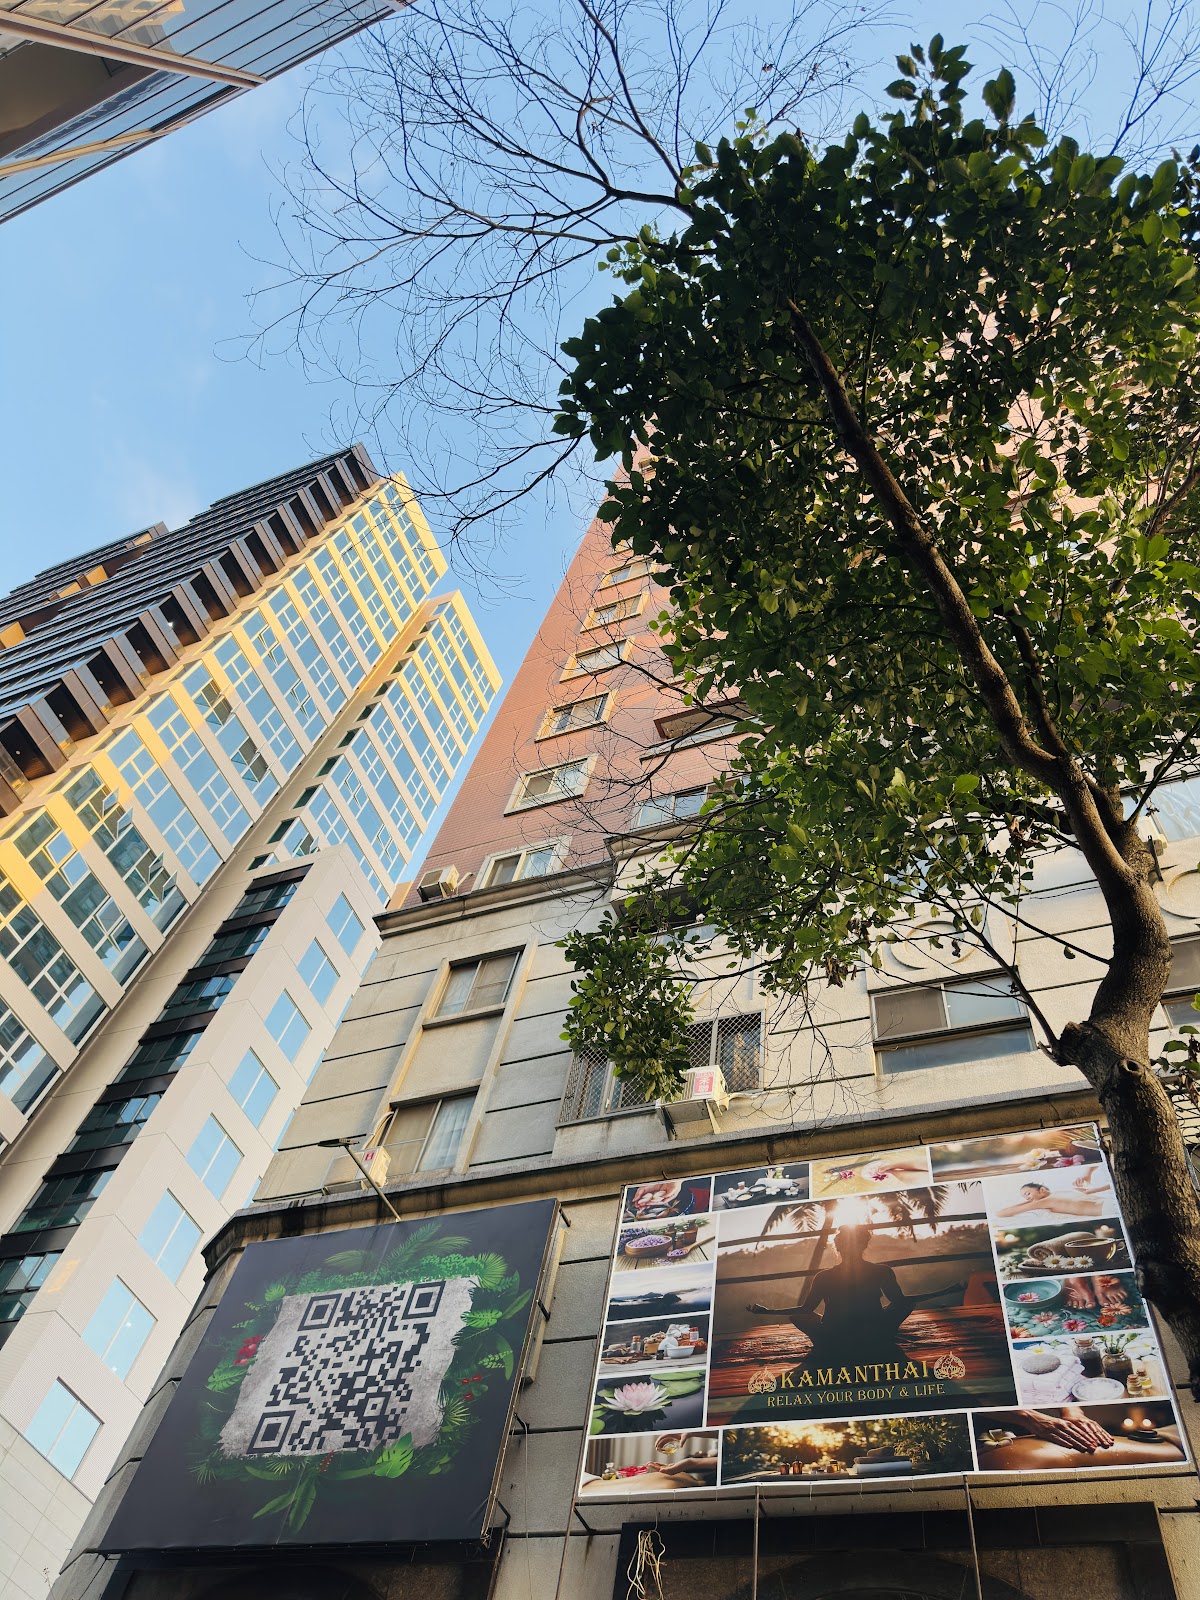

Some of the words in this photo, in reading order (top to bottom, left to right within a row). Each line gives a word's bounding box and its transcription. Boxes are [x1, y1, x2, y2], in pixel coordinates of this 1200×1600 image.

[780, 1360, 928, 1389] KAMANTHAI
[767, 1394, 813, 1408] RELAX
[817, 1390, 854, 1404] YOUR
[857, 1385, 895, 1401] BODY
[899, 1386, 910, 1398] &
[915, 1383, 946, 1397] LIFE
